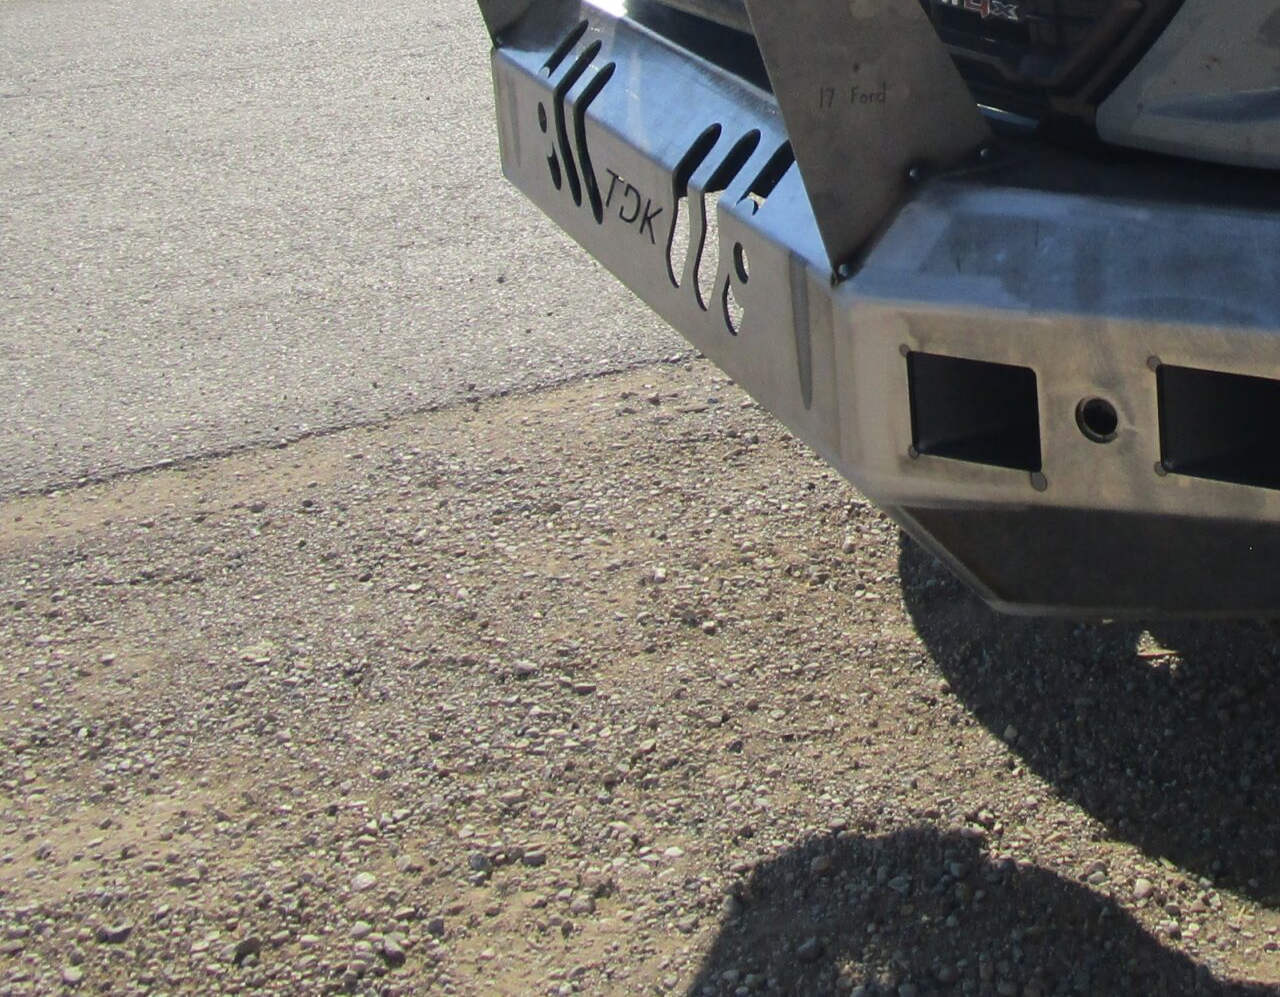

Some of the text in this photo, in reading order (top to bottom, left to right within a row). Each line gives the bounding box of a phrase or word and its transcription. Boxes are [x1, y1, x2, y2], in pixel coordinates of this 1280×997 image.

[819, 81, 887, 109] 17 Ford
[605, 168, 663, 245] TDK
